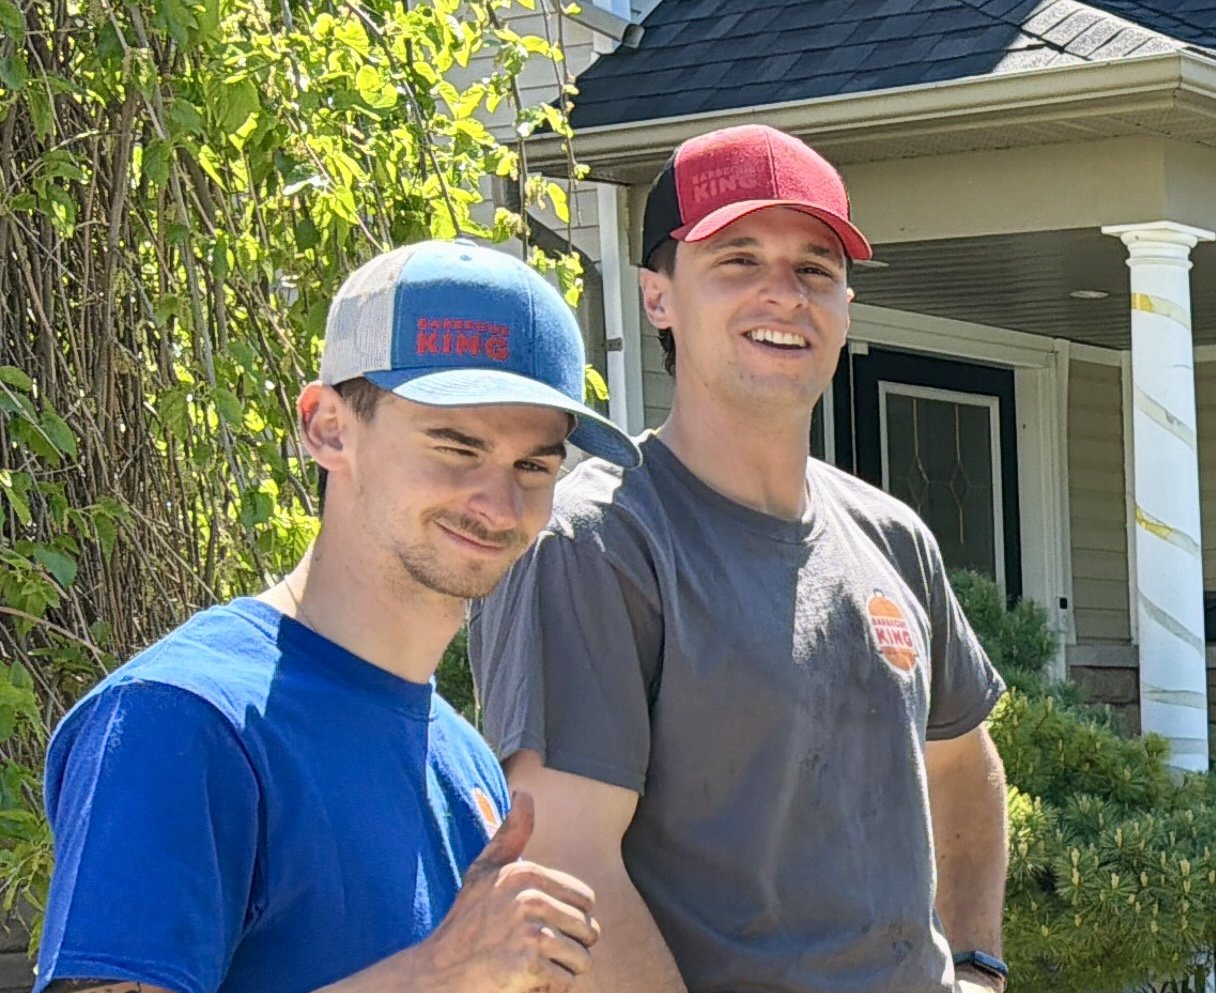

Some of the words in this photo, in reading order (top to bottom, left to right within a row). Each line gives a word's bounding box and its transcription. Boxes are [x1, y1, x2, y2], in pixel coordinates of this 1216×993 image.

[694, 172, 758, 202] KING
[416, 332, 509, 361] KING
[875, 627, 913, 648] KING
